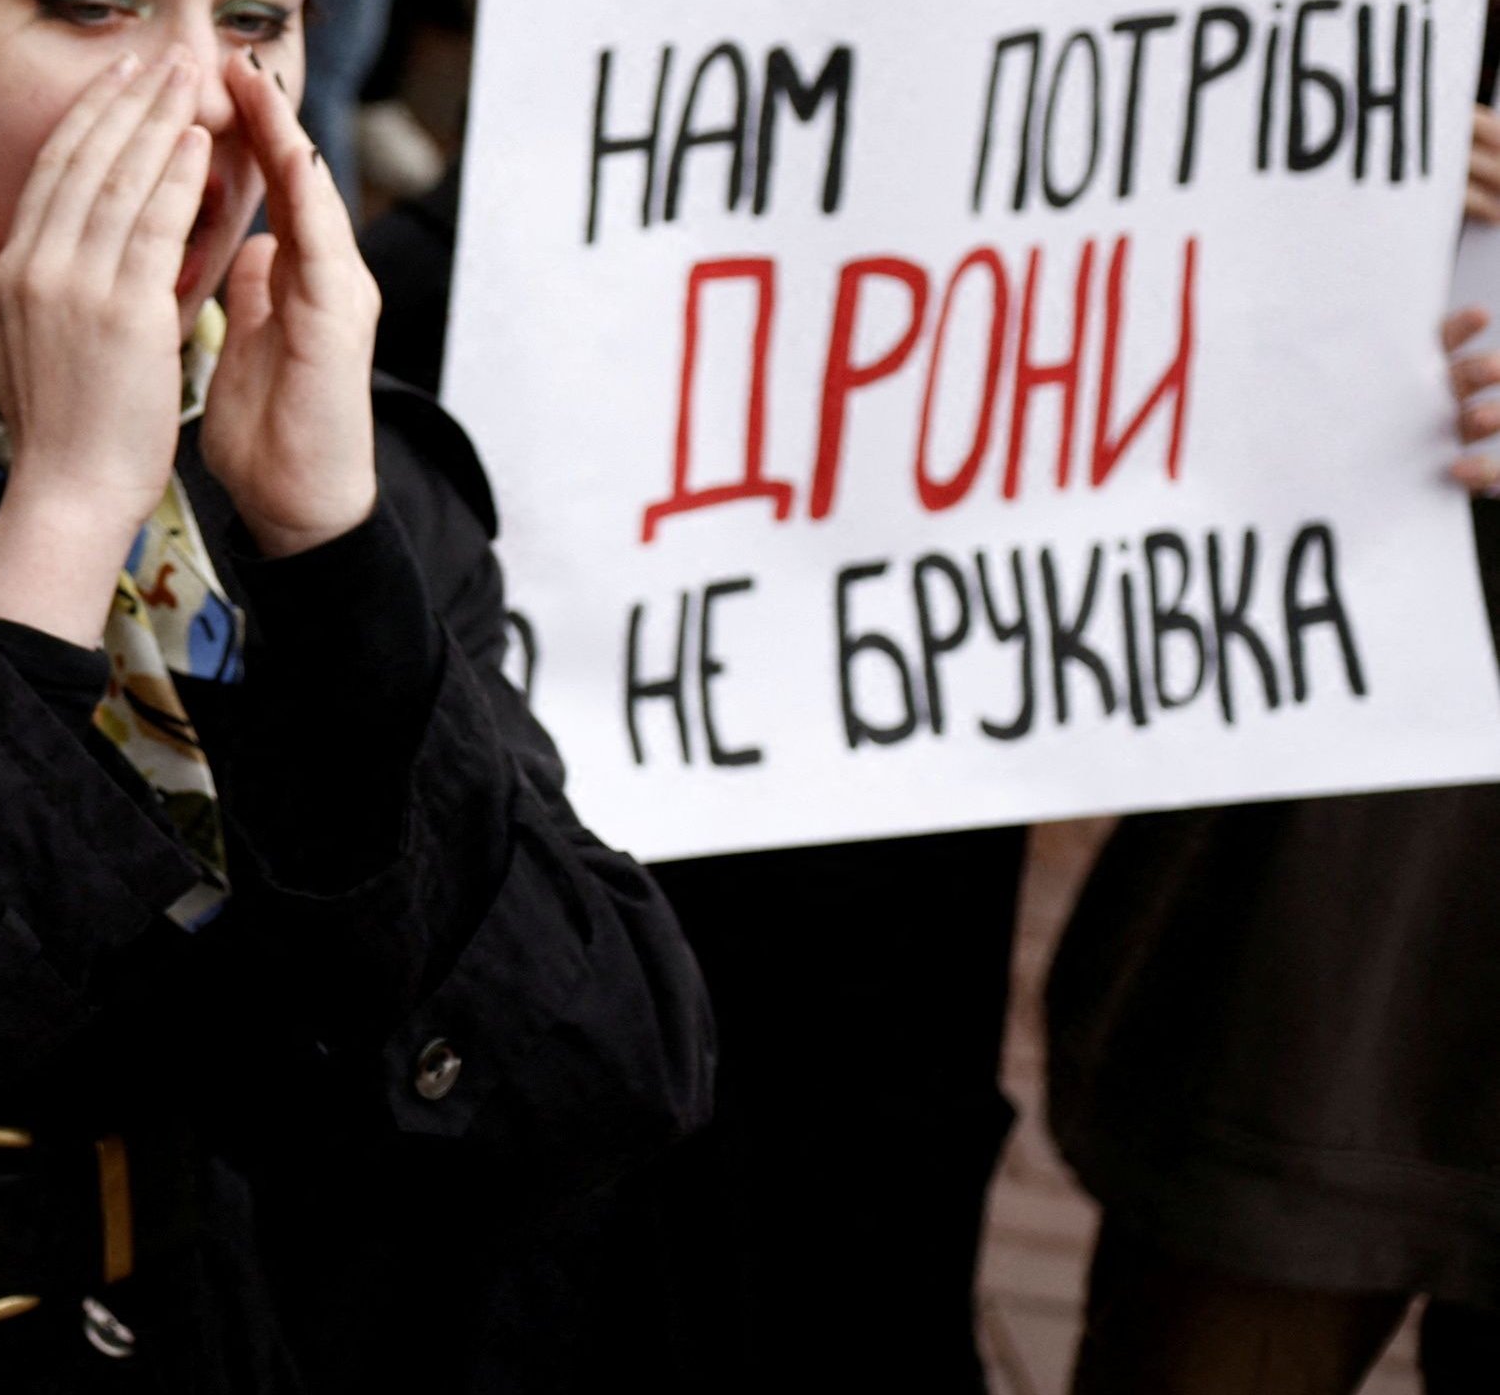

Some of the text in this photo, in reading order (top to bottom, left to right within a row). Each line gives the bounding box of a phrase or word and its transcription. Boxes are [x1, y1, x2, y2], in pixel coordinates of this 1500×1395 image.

[586, 42, 856, 246] НАМ
[640, 234, 1200, 546] ДРОНИ
[626, 576, 764, 766] НЕ
[838, 522, 1368, 749] БРУКІВКА
